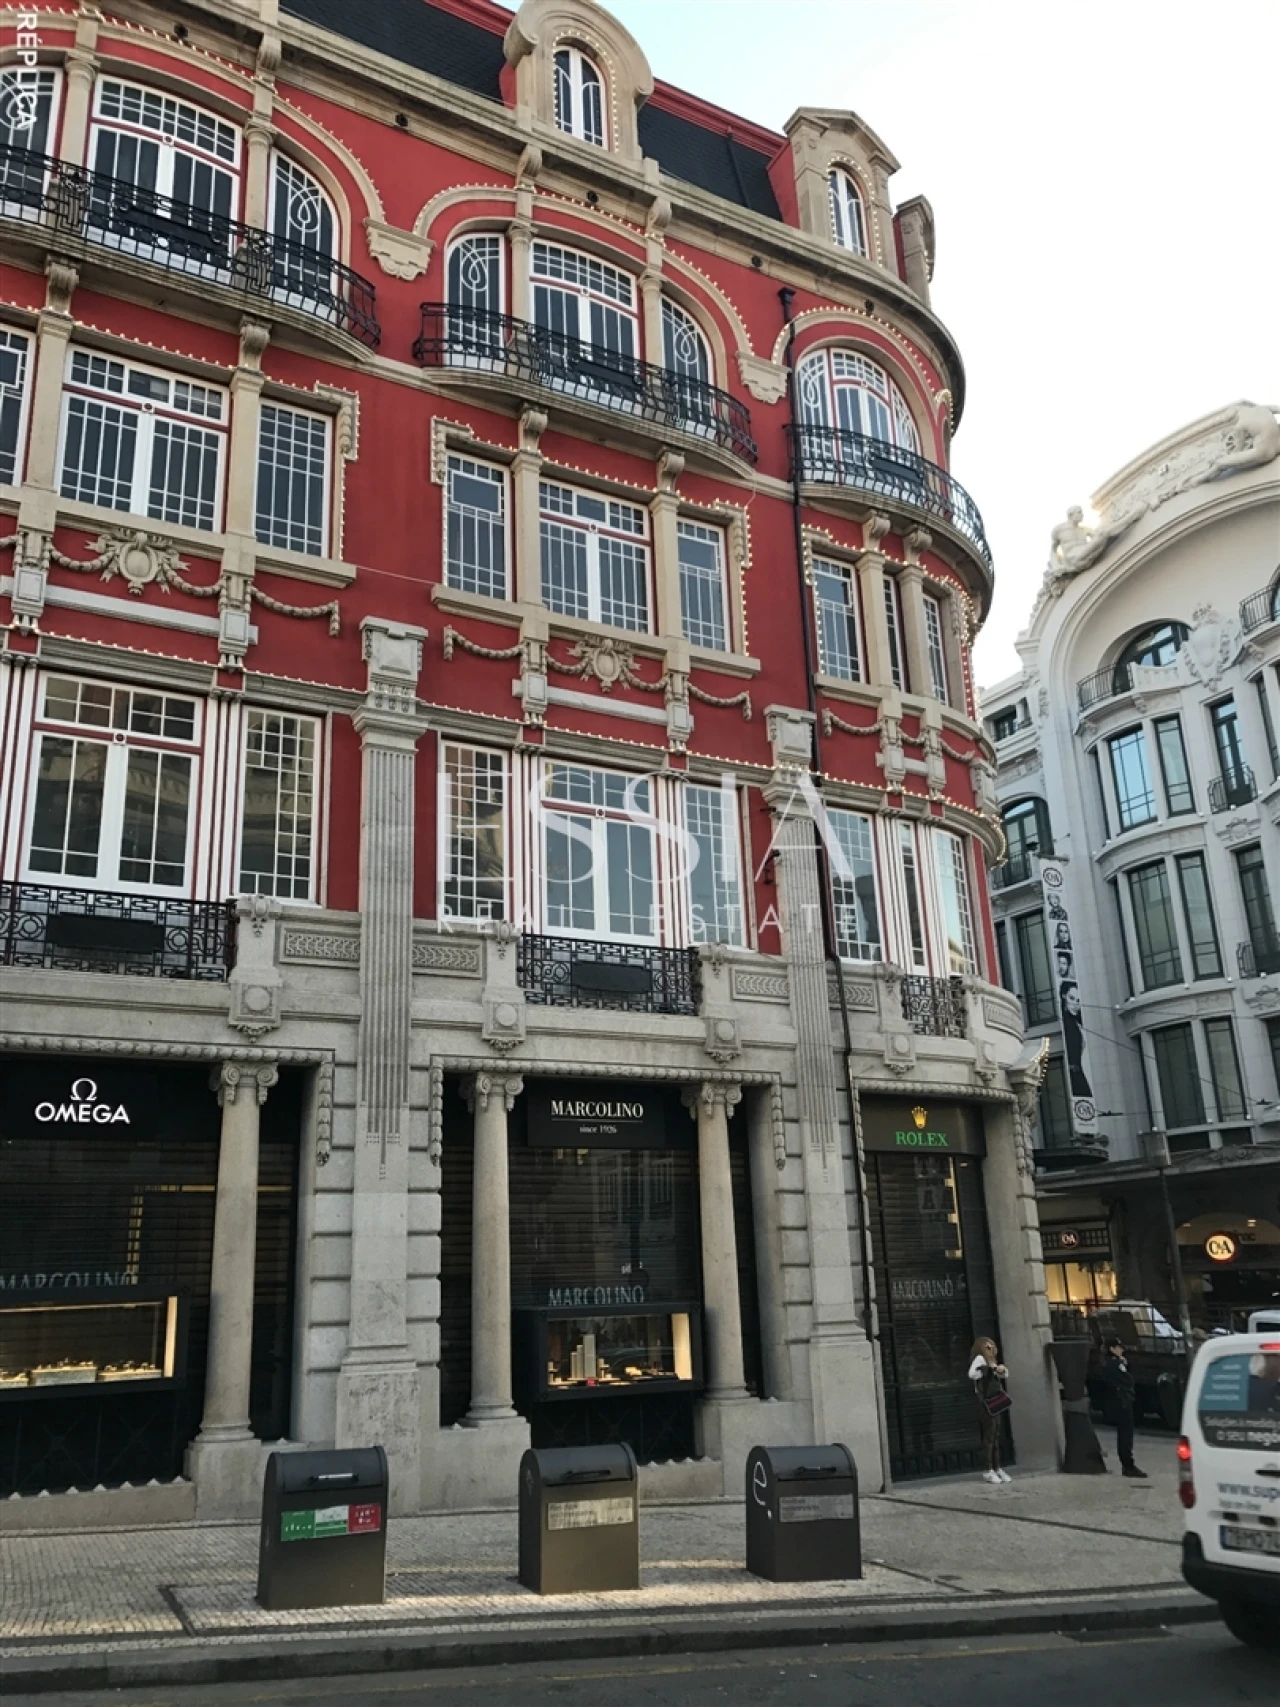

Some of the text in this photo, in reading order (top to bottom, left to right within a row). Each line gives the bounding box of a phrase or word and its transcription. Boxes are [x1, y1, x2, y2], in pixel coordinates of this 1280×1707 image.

[35, 1102, 130, 1124] OMEGA
[551, 1100, 644, 1118] MARCOLINO
[895, 1131, 948, 1147] ROLEX
[1208, 1240, 1232, 1256] C&A
[548, 1285, 645, 1307] MARCOLINO
